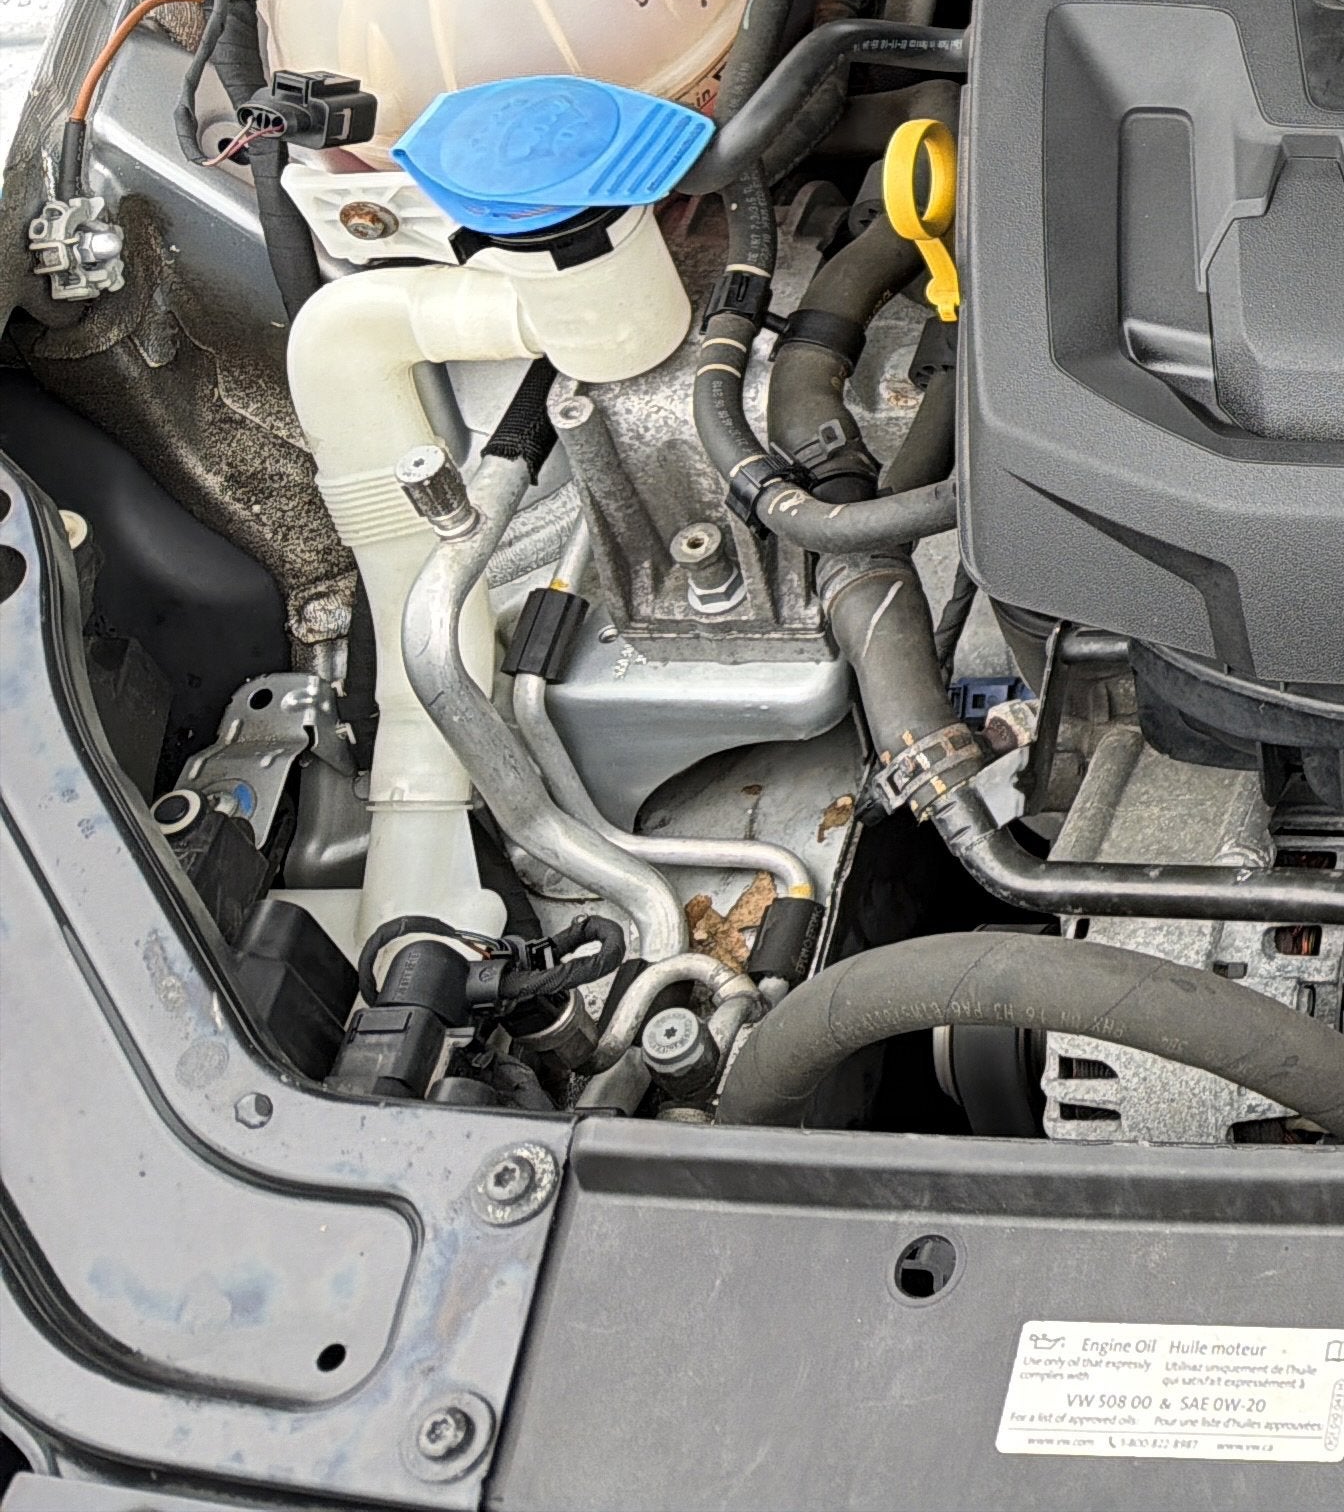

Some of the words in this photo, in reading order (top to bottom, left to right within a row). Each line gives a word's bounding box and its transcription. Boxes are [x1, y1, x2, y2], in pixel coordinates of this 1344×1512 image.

[1081, 1338, 1132, 1357] Engine
[1135, 1339, 1158, 1354] Oil
[1168, 1340, 1207, 1356] Huile
[1211, 1342, 1267, 1356] moteur
[1082, 1357, 1104, 1368] that
[1066, 1393, 1095, 1408] VW
[1099, 1394, 1127, 1409] 508
[1131, 1395, 1153, 1410] 00
[1159, 1397, 1171, 1410] &
[1180, 1396, 1210, 1411] SAE
[1213, 1397, 1267, 1413] 0W-20
[1038, 1412, 1054, 1423] list
